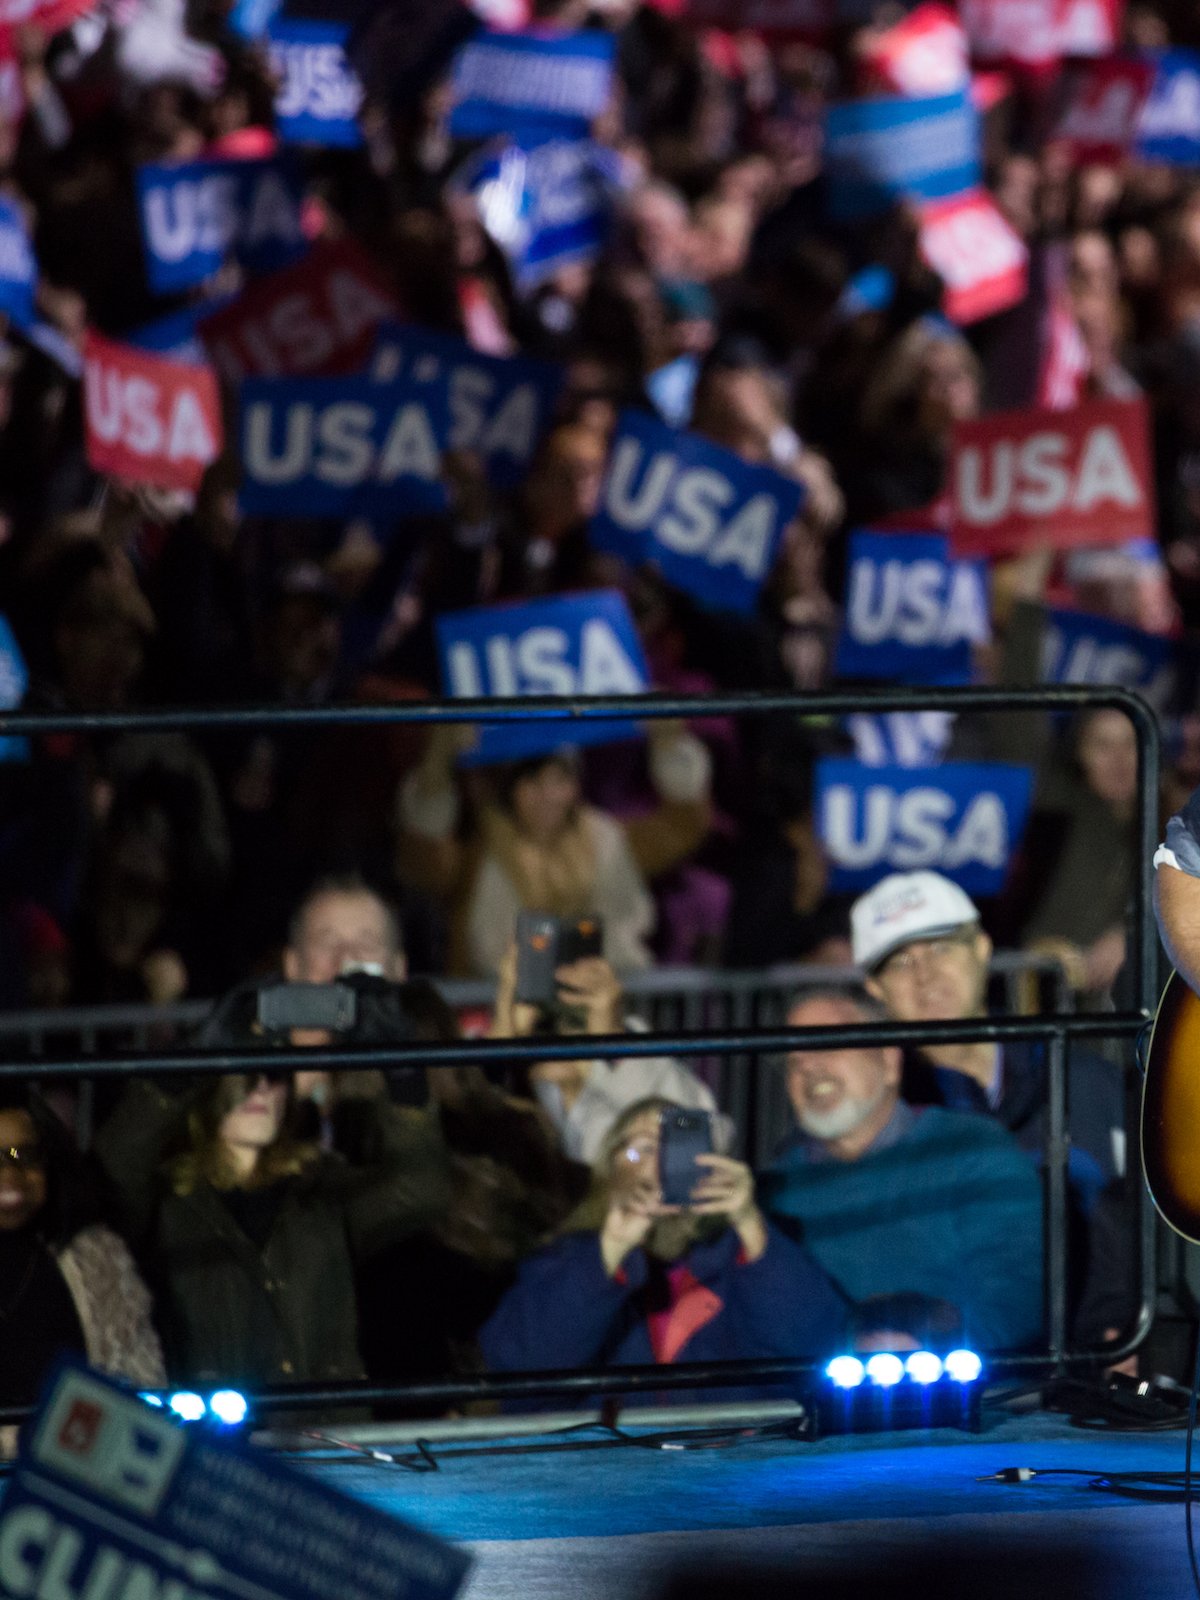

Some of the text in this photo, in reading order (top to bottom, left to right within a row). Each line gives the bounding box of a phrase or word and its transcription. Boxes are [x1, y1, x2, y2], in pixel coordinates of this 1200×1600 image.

[86, 362, 217, 463] USA
[246, 402, 440, 487] USA
[608, 434, 778, 582] USA
[957, 422, 1142, 522] USA
[850, 557, 990, 646] USA
[825, 785, 1008, 870] USA
